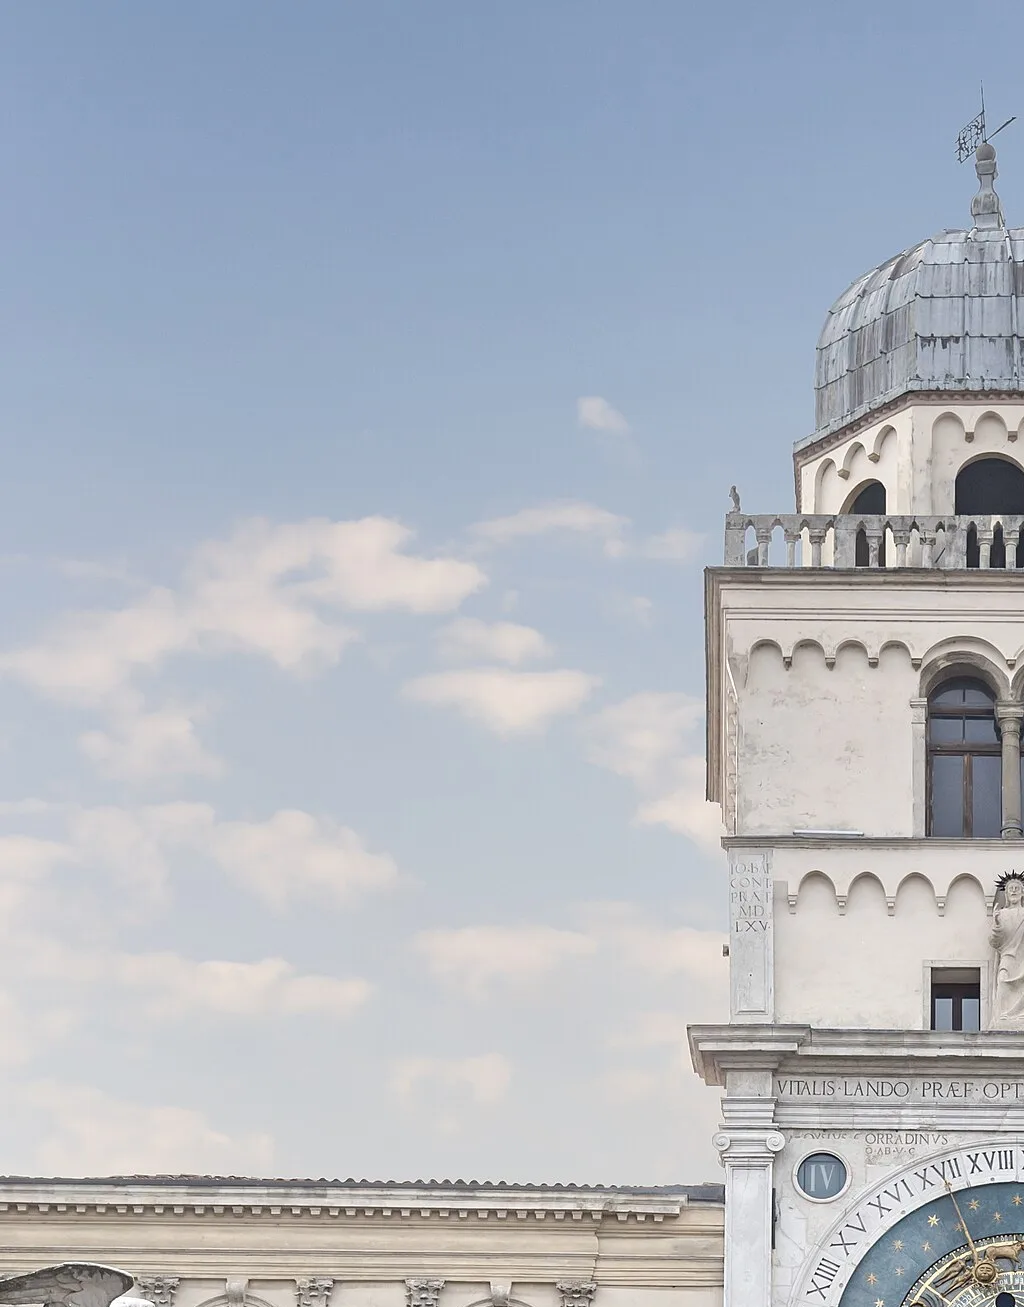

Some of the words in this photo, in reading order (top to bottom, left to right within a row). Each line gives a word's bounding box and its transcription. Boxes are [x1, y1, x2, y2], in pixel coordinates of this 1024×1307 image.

[778, 1080, 835, 1097] VITALIS
[844, 1081, 910, 1097] LANDO
[983, 1082, 1024, 1099] OPT
[810, 1164, 835, 1192] IV
[914, 1158, 961, 1190] XVII
[967, 1150, 1014, 1174] XVIII
[867, 1179, 914, 1218] XVI
[830, 1212, 867, 1256] XV
[807, 1257, 840, 1300] XIIII
